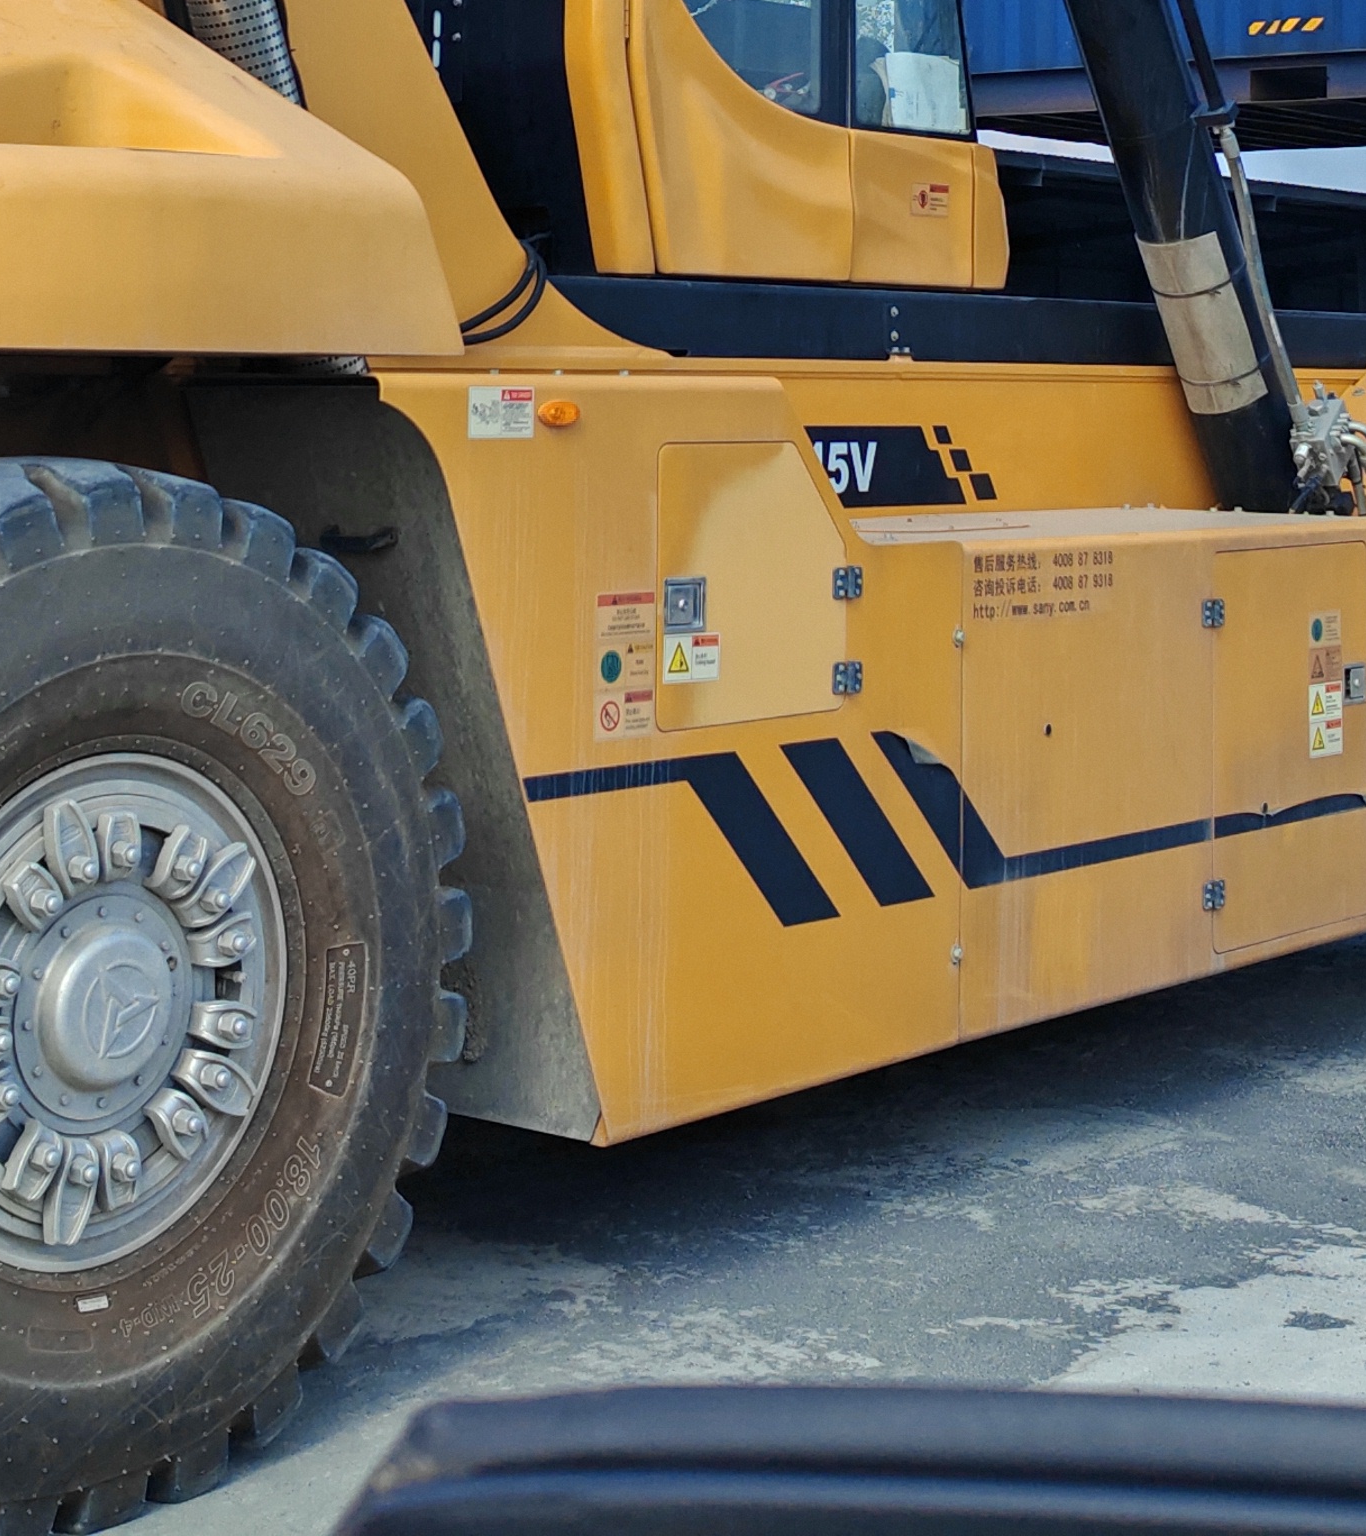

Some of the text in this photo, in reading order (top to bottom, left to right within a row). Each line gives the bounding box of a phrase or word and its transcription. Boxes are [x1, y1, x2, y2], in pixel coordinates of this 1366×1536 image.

[1052, 552, 1073, 568] 4008
[1078, 552, 1088, 566] 87
[1052, 575, 1073, 591] 4008
[1078, 575, 1088, 589] 87
[1092, 573, 1113, 588] 9318
[181, 681, 317, 796] CL629
[187, 1136, 321, 1319] 18.00-25
